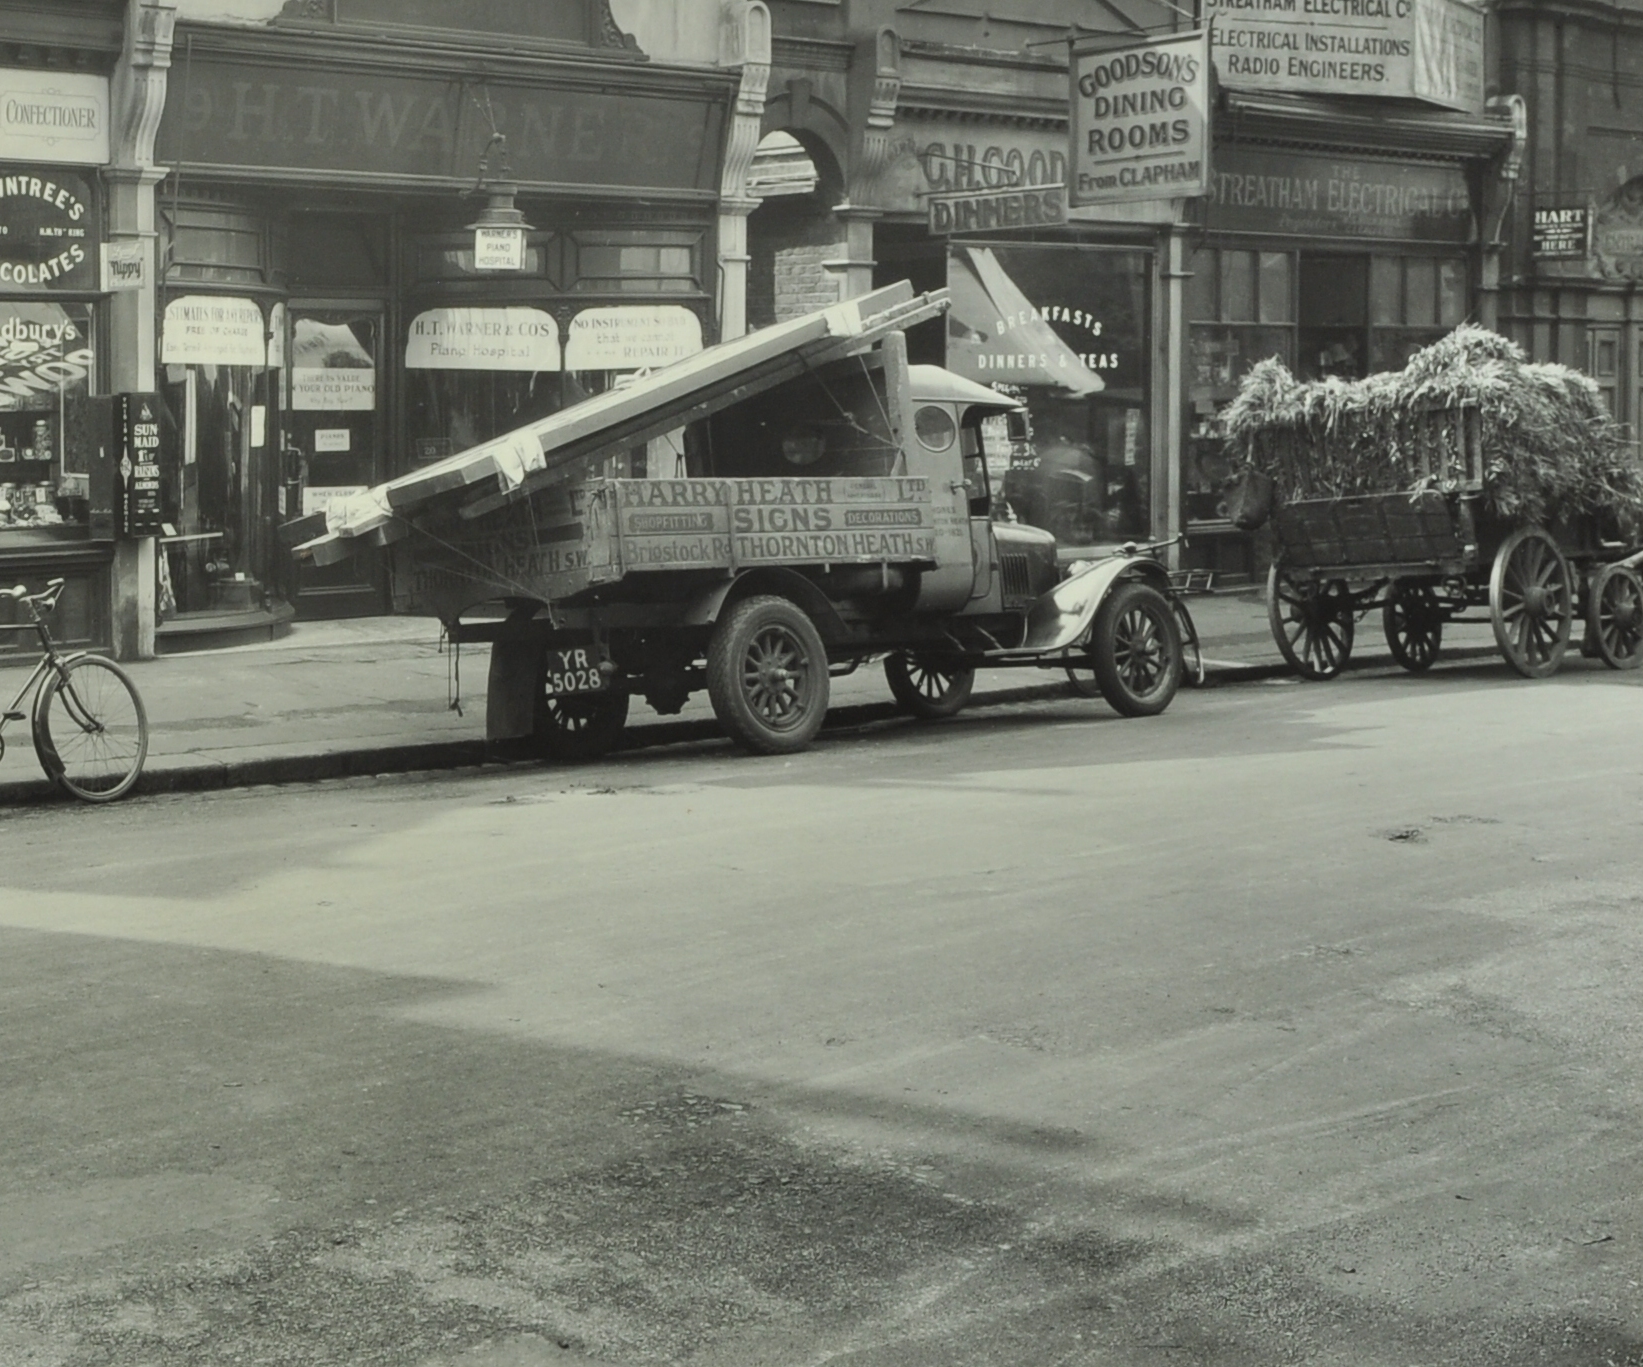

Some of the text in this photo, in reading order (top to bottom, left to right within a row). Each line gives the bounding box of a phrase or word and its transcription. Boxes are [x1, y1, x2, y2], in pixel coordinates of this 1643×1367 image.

[1211, 27, 1411, 57] ELECTRICAL INSTALLATIONS
[1078, 50, 1200, 99] GOODSON'S
[1228, 54, 1390, 82] RADIO ENGINEERS.
[5, 98, 97, 130] CONFECTIONER
[1093, 86, 1187, 120] DINING
[1087, 118, 1190, 155] ROOMS
[1078, 160, 1201, 191] From CLAPHAM
[1327, 178, 1444, 217] ELECTRICAL
[932, 191, 1064, 232] DINNERS
[1535, 209, 1584, 224] HART
[68, 228, 85, 237] KING
[486, 243, 511, 252] PIANO
[479, 256, 515, 266] HOSPITAL
[447, 321, 502, 337] WARNER
[573, 318, 589, 330] NO
[996, 306, 1103, 337] BREAKFASTS
[596, 332, 620, 344] that
[431, 342, 530, 359] Piano Hospital
[623, 345, 670, 359] REPAIR
[978, 352, 1119, 370] DINNERS & TEAS
[299, 384, 375, 393] YOUR OLD PIANO
[134, 424, 158, 436] SUN
[134, 436, 159, 448] MAID
[622, 481, 727, 507] HARRY
[736, 480, 834, 506] HEATH
[634, 514, 708, 530] SHOPFITTING
[734, 507, 832, 533] SIGNS
[847, 512, 919, 524] DECORATIONS
[736, 534, 850, 559] THORNTON
[853, 533, 914, 556] HEATH
[557, 648, 589, 670] YR
[553, 668, 602, 692] 5028
